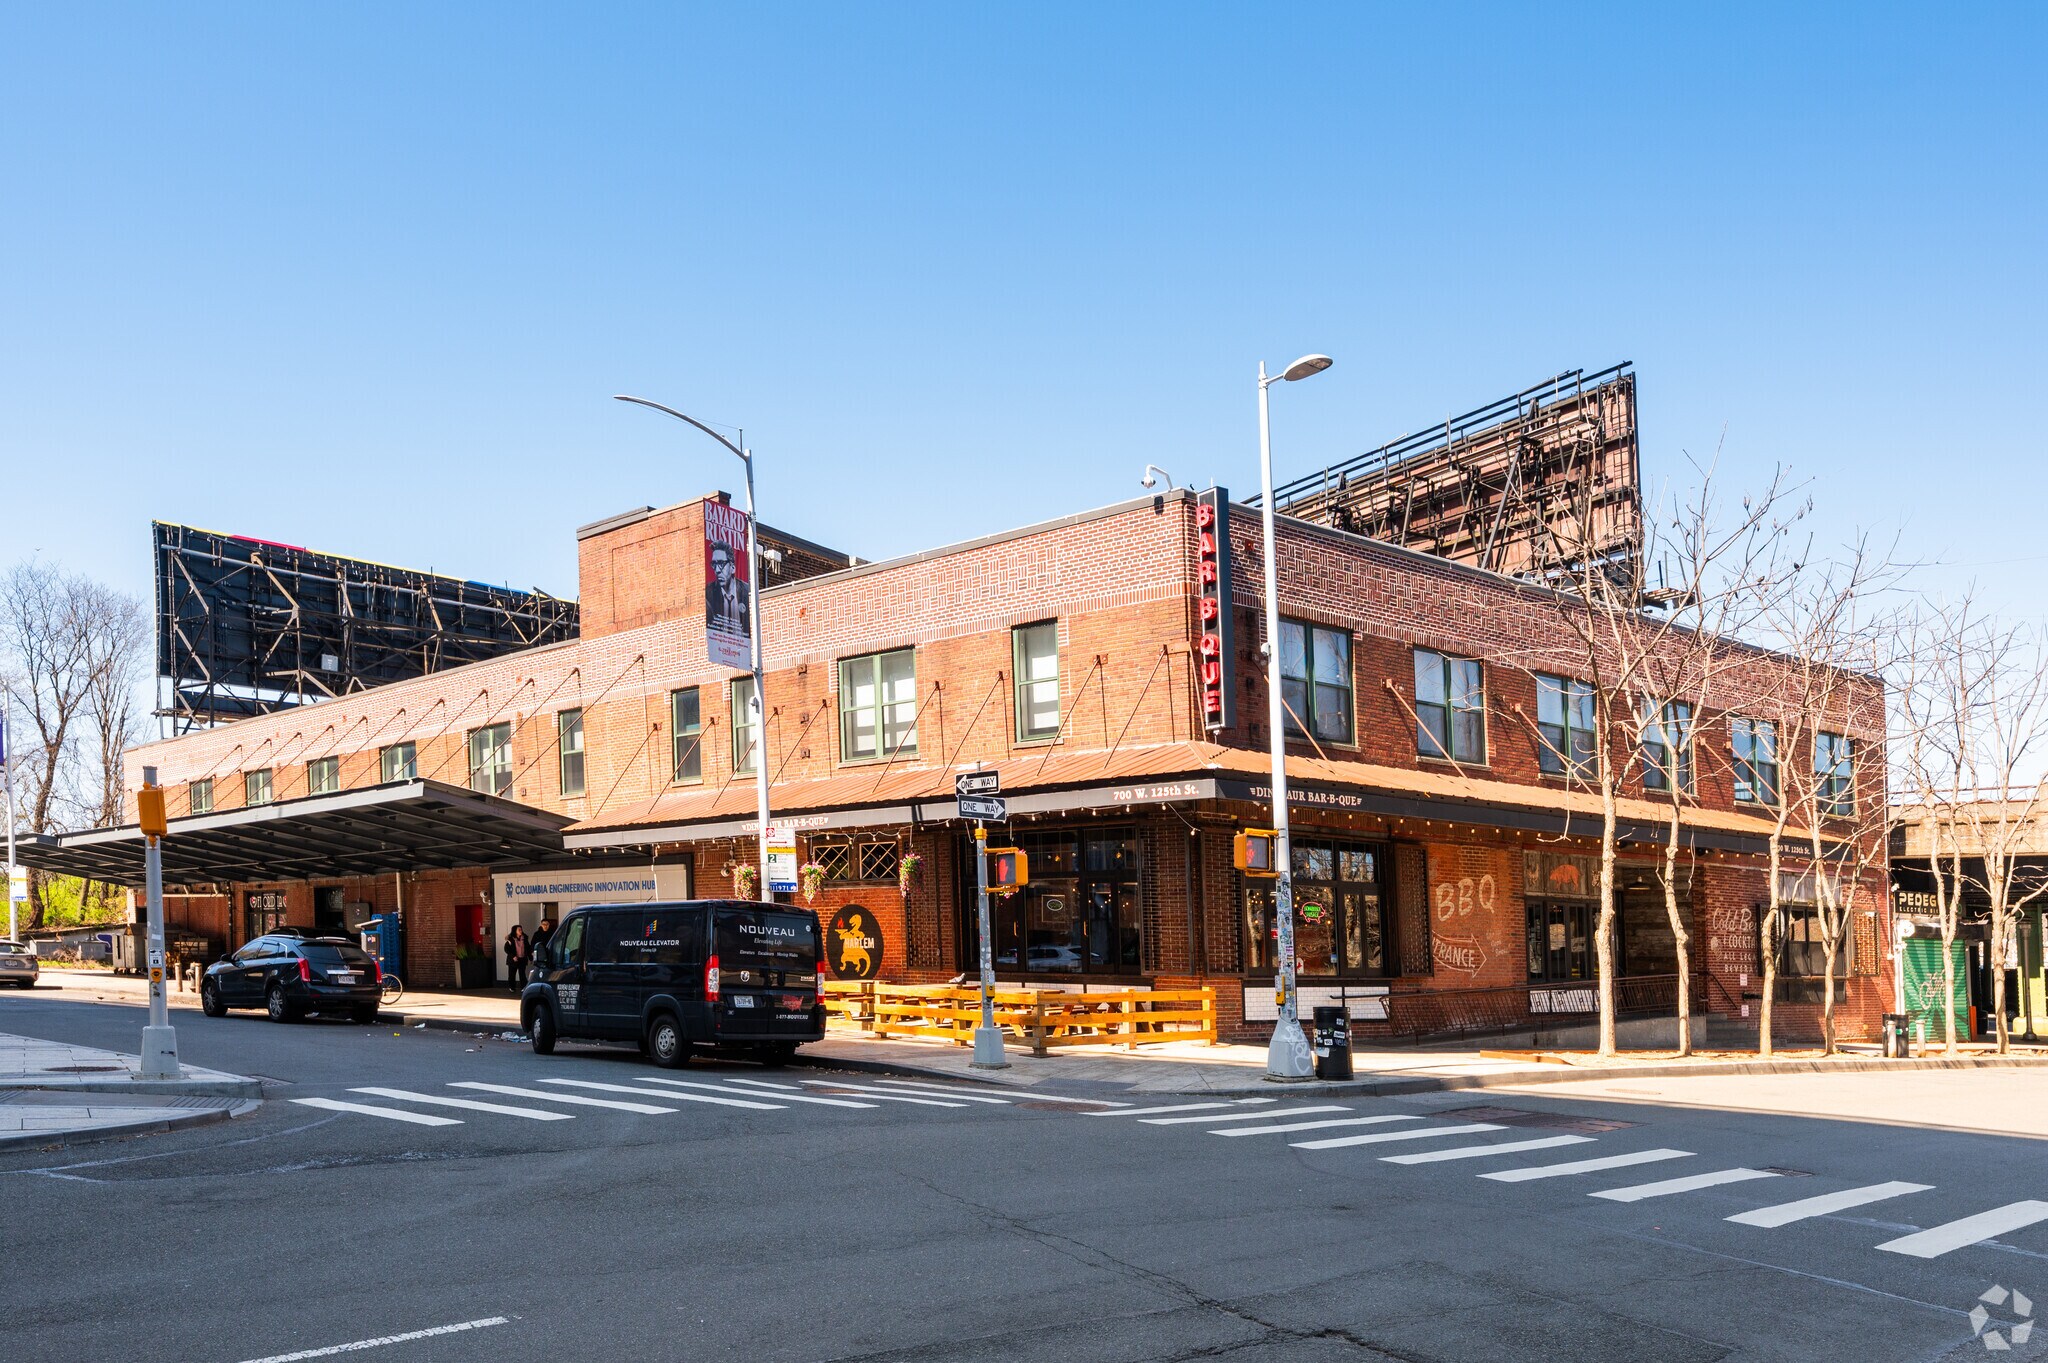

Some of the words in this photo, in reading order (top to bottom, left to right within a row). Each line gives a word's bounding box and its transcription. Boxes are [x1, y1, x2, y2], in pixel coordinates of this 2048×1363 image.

[704, 501, 745, 533] BAYARD
[705, 521, 745, 552] RUSTIN
[961, 780, 974, 789] ONE
[981, 777, 995, 787] WAY
[1113, 791, 1132, 801] 700
[1134, 789, 1148, 799] W.
[1150, 786, 1182, 798] 125th
[1184, 784, 1199, 795] St.
[1256, 787, 1306, 801] DINAUR
[963, 802, 977, 811] ONE
[984, 804, 1000, 813] WAY
[515, 884, 548, 895] COLUMBIA
[550, 882, 593, 893] ENGINEERING
[594, 881, 640, 892] INNOVATION
[641, 880, 655, 890] HUB
[1436, 874, 1495, 921] BBQ
[1712, 907, 1737, 932] Cold
[740, 924, 795, 937] NOUVEAU
[844, 937, 875, 949] HARLEM
